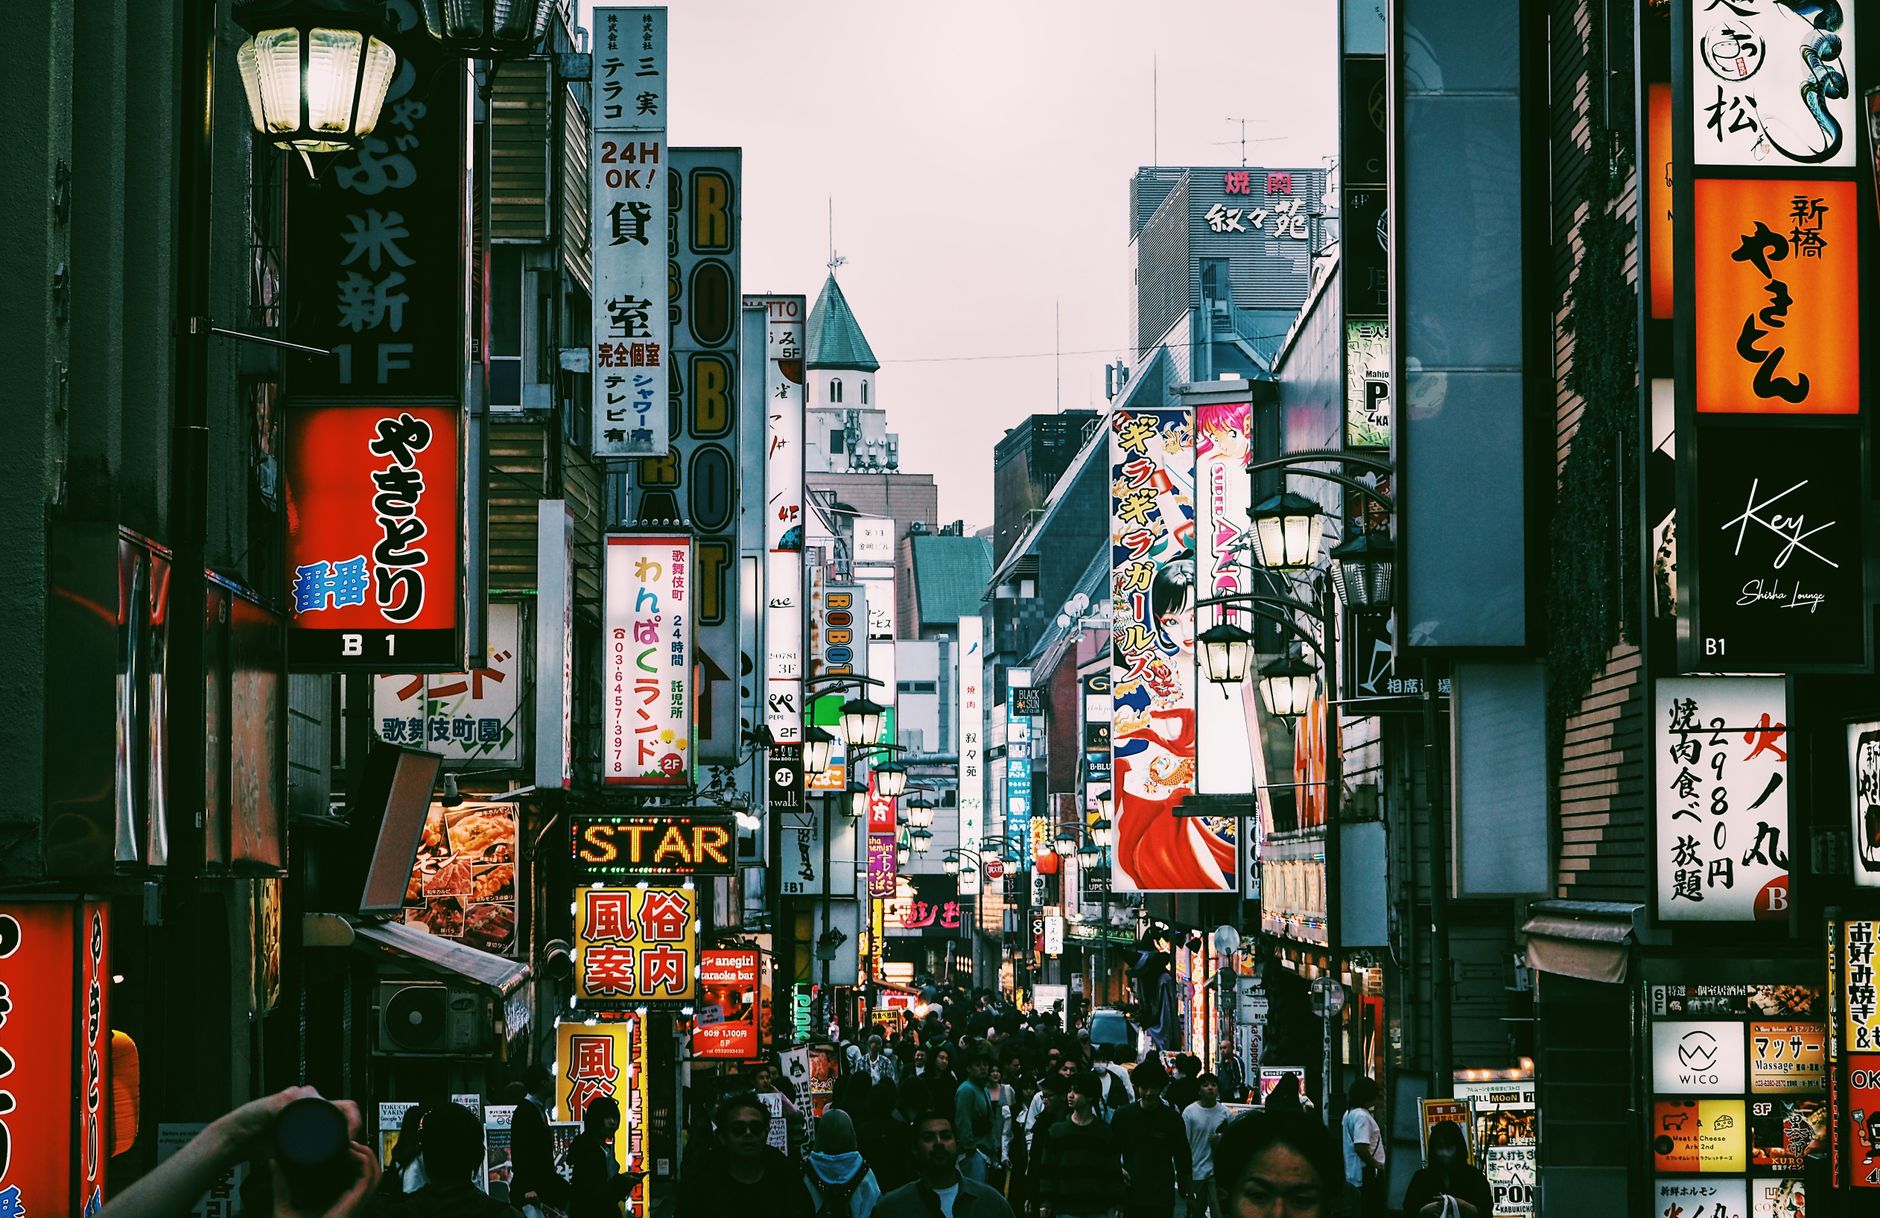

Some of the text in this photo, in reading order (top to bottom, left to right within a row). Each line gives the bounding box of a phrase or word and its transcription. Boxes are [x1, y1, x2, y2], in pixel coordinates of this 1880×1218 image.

[601, 14, 624, 119] 株式会社 テラコ
[635, 14, 660, 116] 株式会社 三実
[601, 142, 659, 164] 24H
[605, 169, 656, 189] OK!
[1225, 171, 1292, 195] 焼肉
[1788, 195, 1829, 259] 新橋
[1731, 221, 1810, 404] やきとん
[598, 342, 661, 368] 完全個室
[783, 348, 800, 358] 5F
[369, 413, 433, 623] やきとり
[1721, 478, 1839, 569] Key
[1118, 416, 1159, 682] ギラギラガールズ
[1736, 579, 1825, 614] Shisha Lounge
[670, 550, 684, 719] 歌舞伎町 24時間 託児所
[1706, 638, 1725, 656] B1
[634, 556, 662, 766] わんぱくランド
[1019, 689, 1040, 700] BLACK
[1026, 700, 1040, 709] SUN
[383, 717, 502, 742] 歌舞伎町園
[780, 728, 798, 738] 2F
[663, 759, 680, 770] 2F
[777, 772, 791, 782] 2F
[1669, 698, 1705, 902] 焼肉食べ放題
[1707, 717, 1734, 890] 2980円
[1741, 712, 1789, 872] 火ノ丸
[580, 825, 729, 863] STAR
[790, 882, 804, 892] B1
[581, 890, 690, 942] 風俗
[583, 945, 688, 995] 案内
[715, 955, 754, 968] anegirl
[738, 970, 754, 980] bar
[1754, 1035, 1824, 1060] マッサー
[1679, 1075, 1718, 1084] WICO
[1755, 1060, 1793, 1074] Massage
[1753, 1103, 1771, 1115] 3F
[1772, 1157, 1804, 1165] KURO
[1660, 1186, 1718, 1197] 新鮮ホルモン
